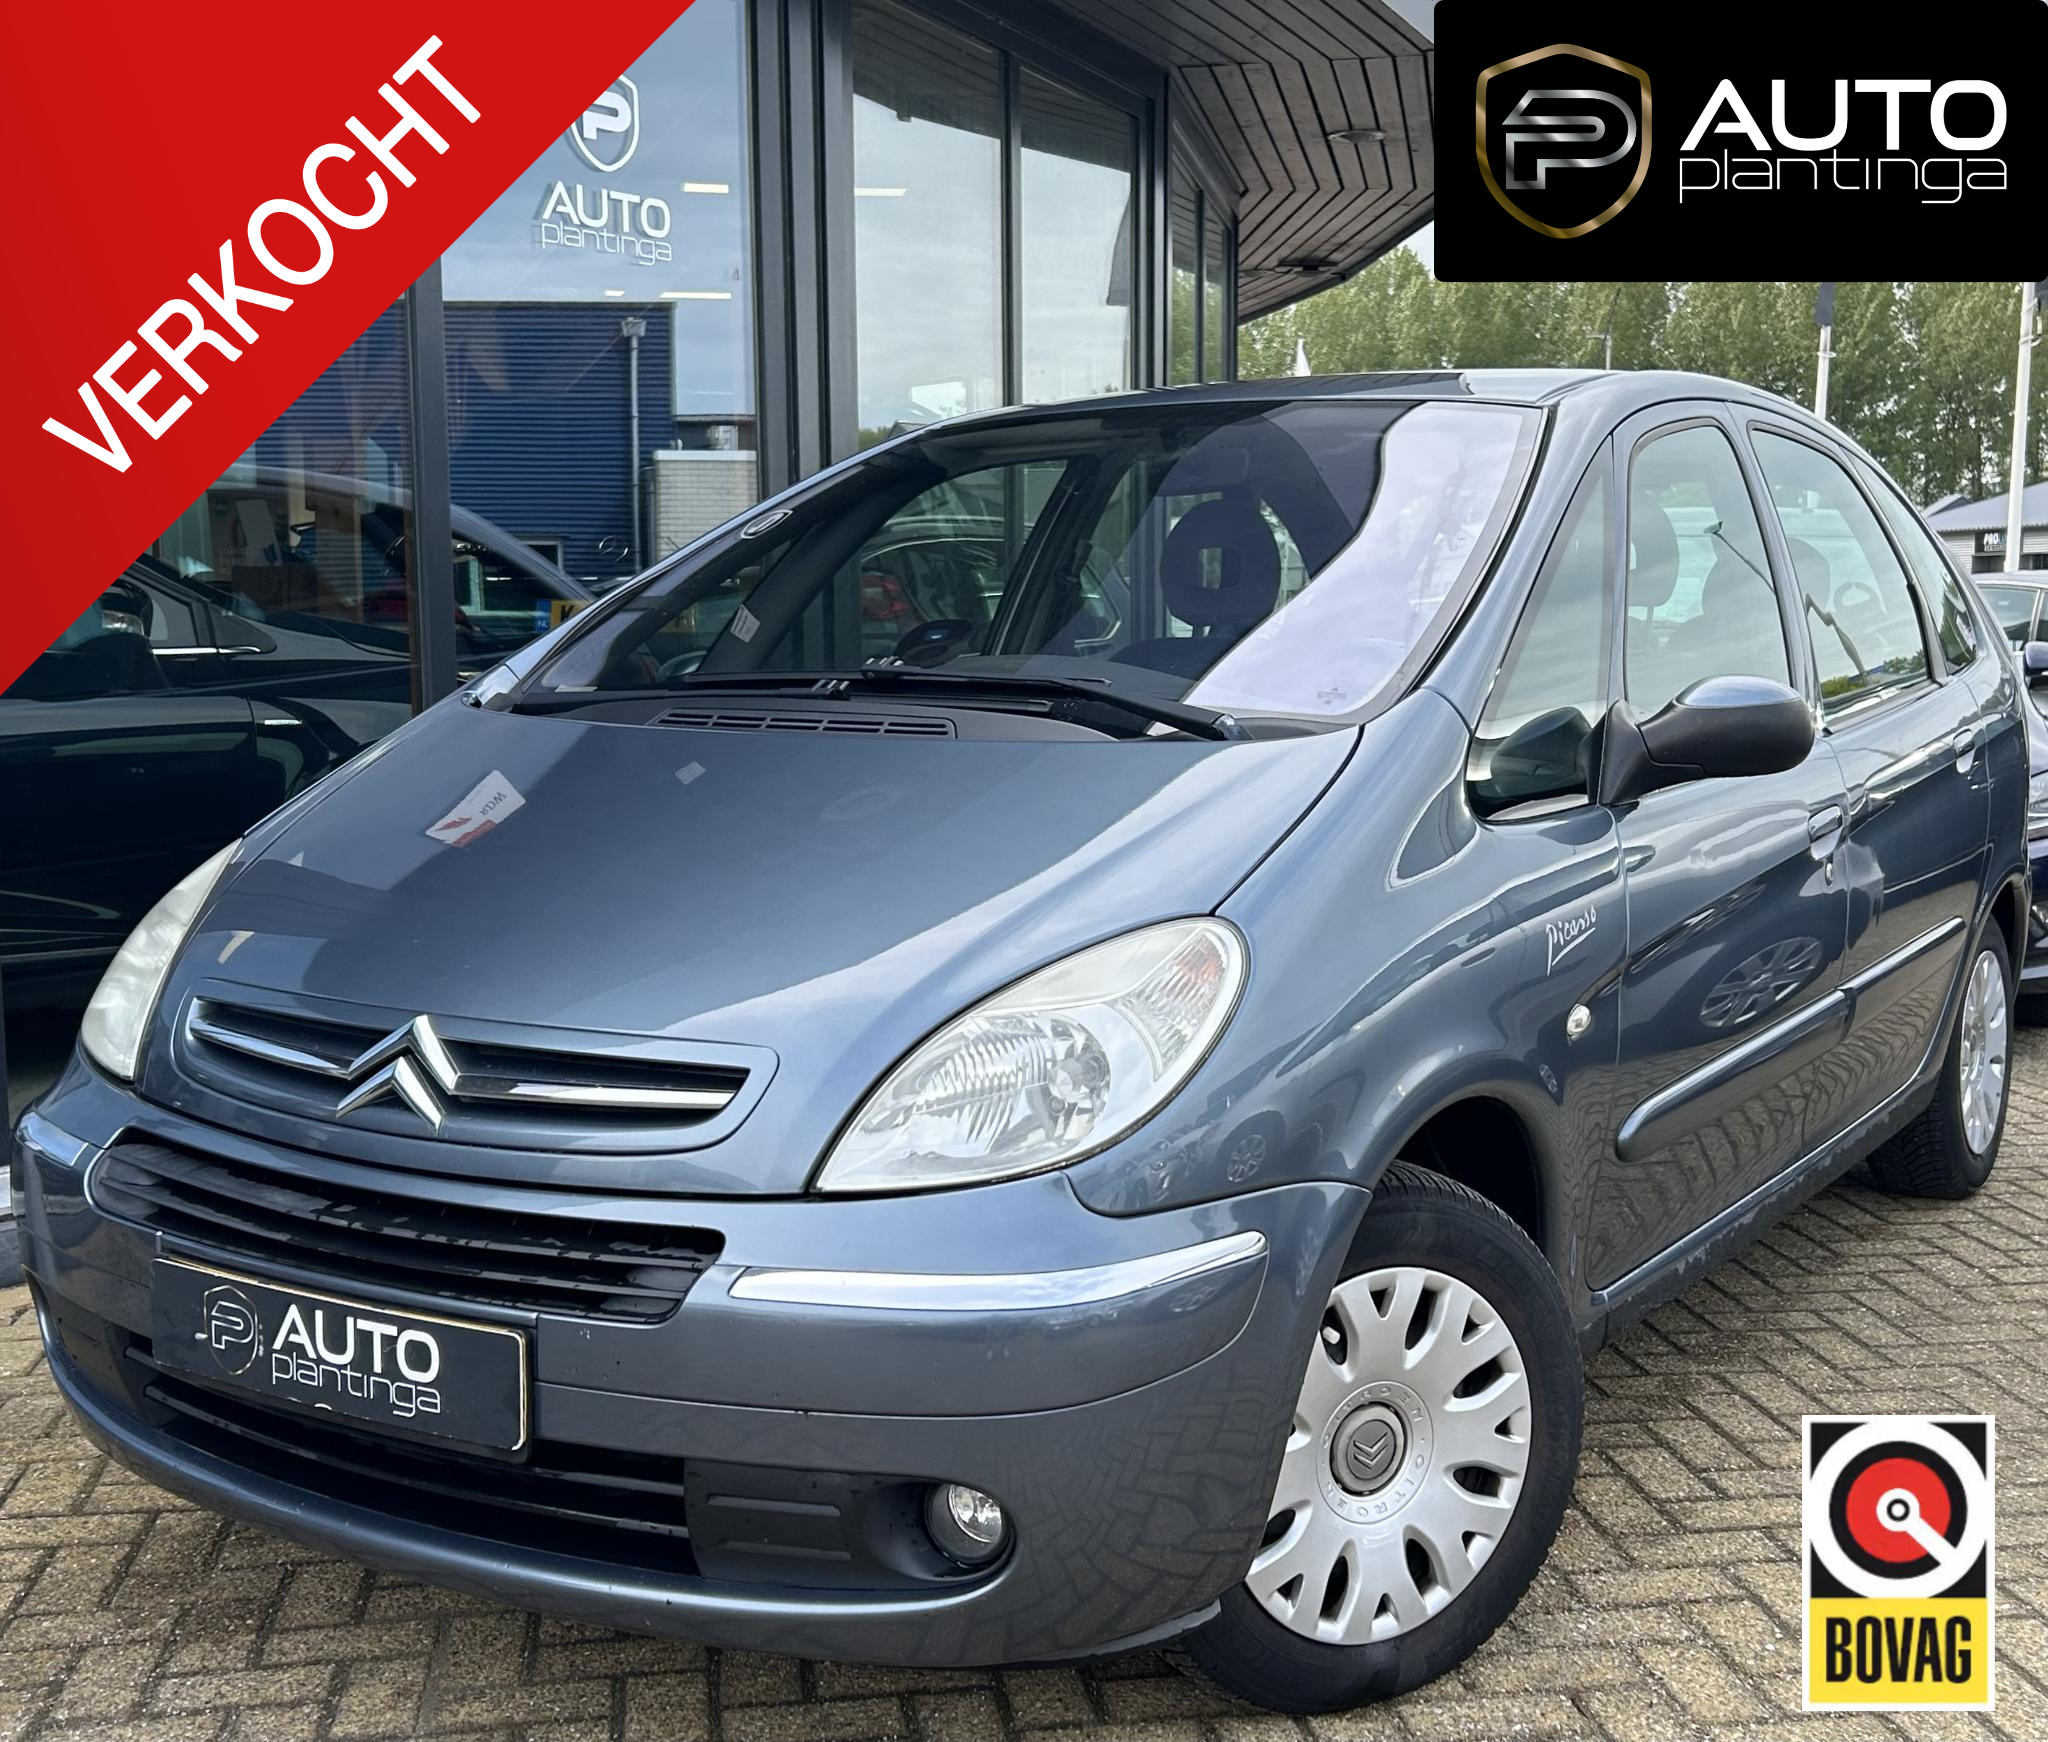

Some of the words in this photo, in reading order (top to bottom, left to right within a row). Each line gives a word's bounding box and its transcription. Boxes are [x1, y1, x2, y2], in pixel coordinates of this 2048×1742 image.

[540, 219, 672, 266] plantinga
[541, 180, 671, 239] AUTO
[1544, 904, 1598, 977] Picasso
[271, 1303, 440, 1384] AUTO
[271, 1351, 442, 1418] plantinga
